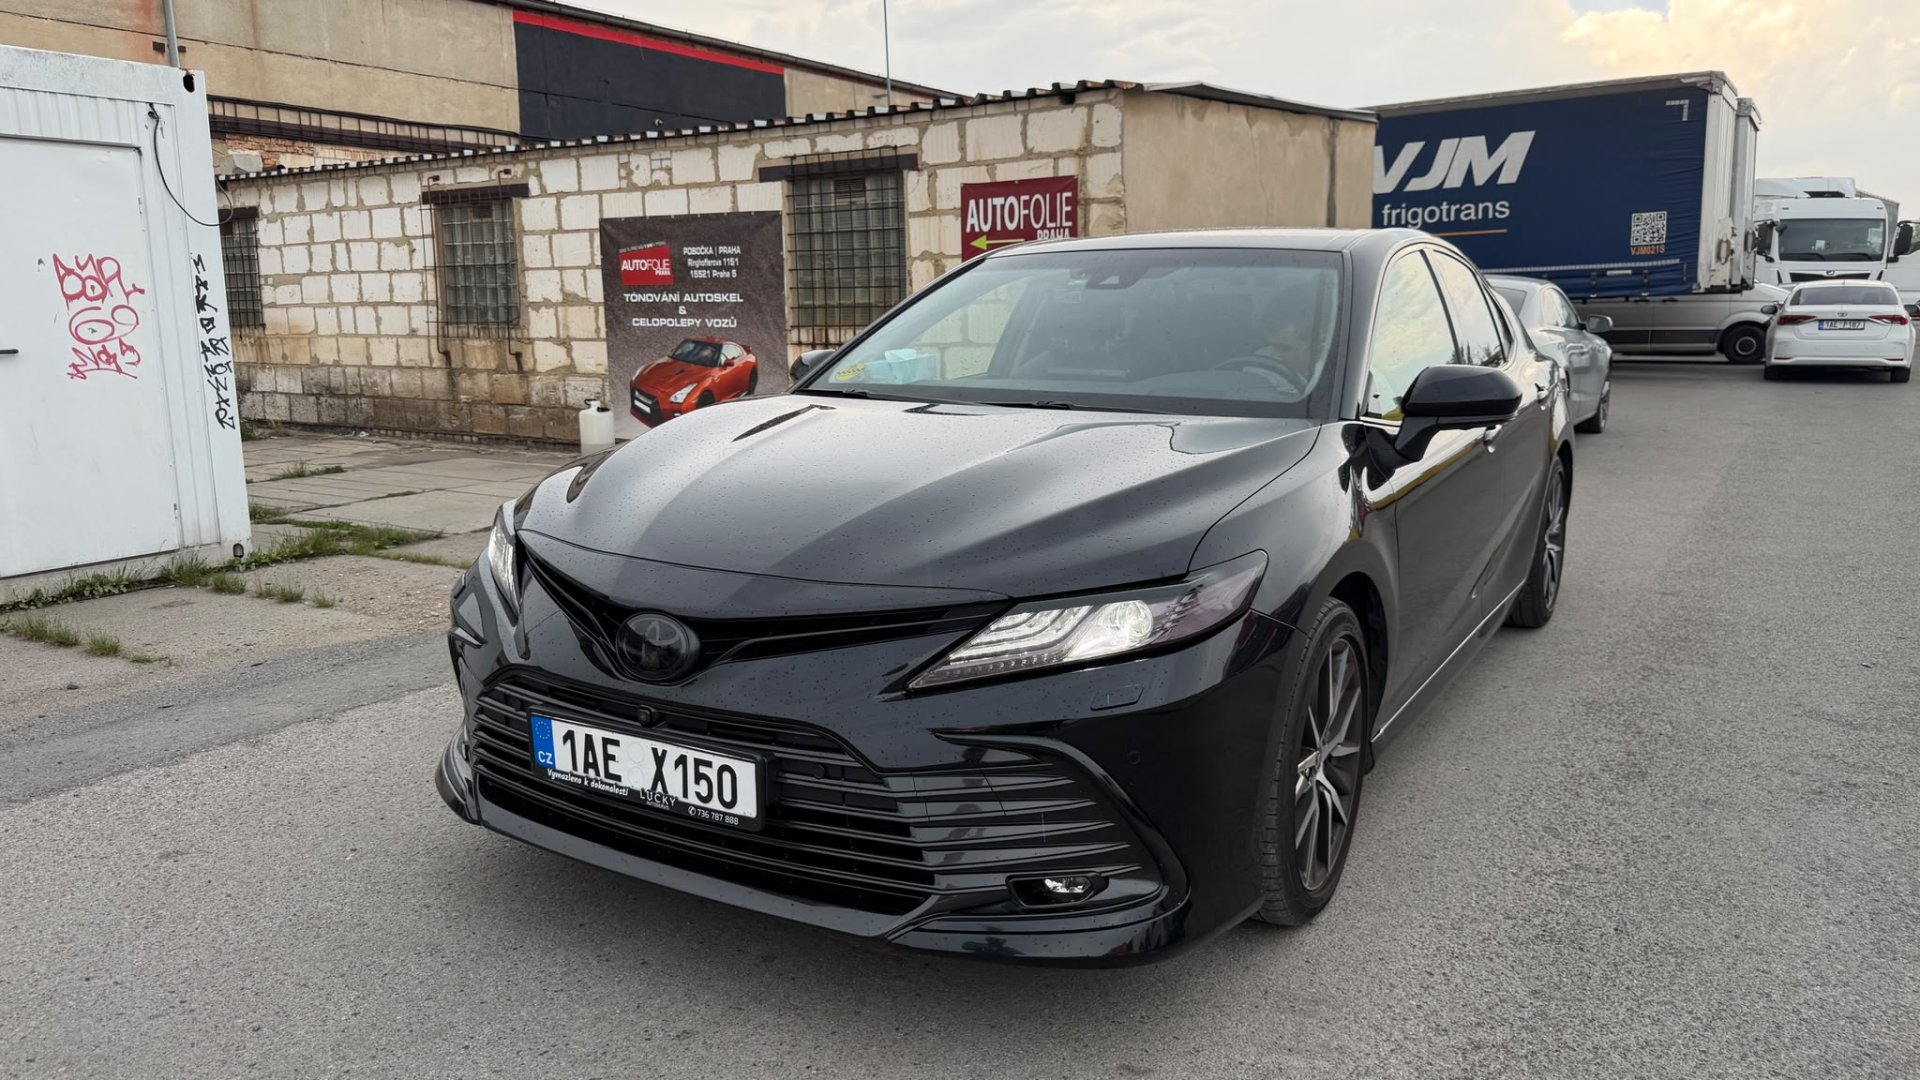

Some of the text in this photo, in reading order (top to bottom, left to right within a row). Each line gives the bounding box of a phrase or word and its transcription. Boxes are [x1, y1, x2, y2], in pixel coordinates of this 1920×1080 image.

[1373, 130, 1536, 195] VJM
[966, 191, 1073, 234] AUTOFOLIE
[1382, 200, 1510, 229] frigotrans
[683, 245, 742, 256] POBOČKA PRAHA
[723, 257, 739, 266] 1151
[712, 269, 730, 278] Praha
[624, 291, 743, 303] TÓNOVÁNÍ AUTOSKEL
[678, 306, 687, 315] &
[632, 316, 737, 328] CELOPOLEPY VOZŮ
[538, 750, 553, 765] CZ
[562, 729, 738, 810] 1AE X150
[584, 777, 589, 786] k
[639, 789, 676, 807] LUCKY
[697, 808, 739, 826] 736 787 888
